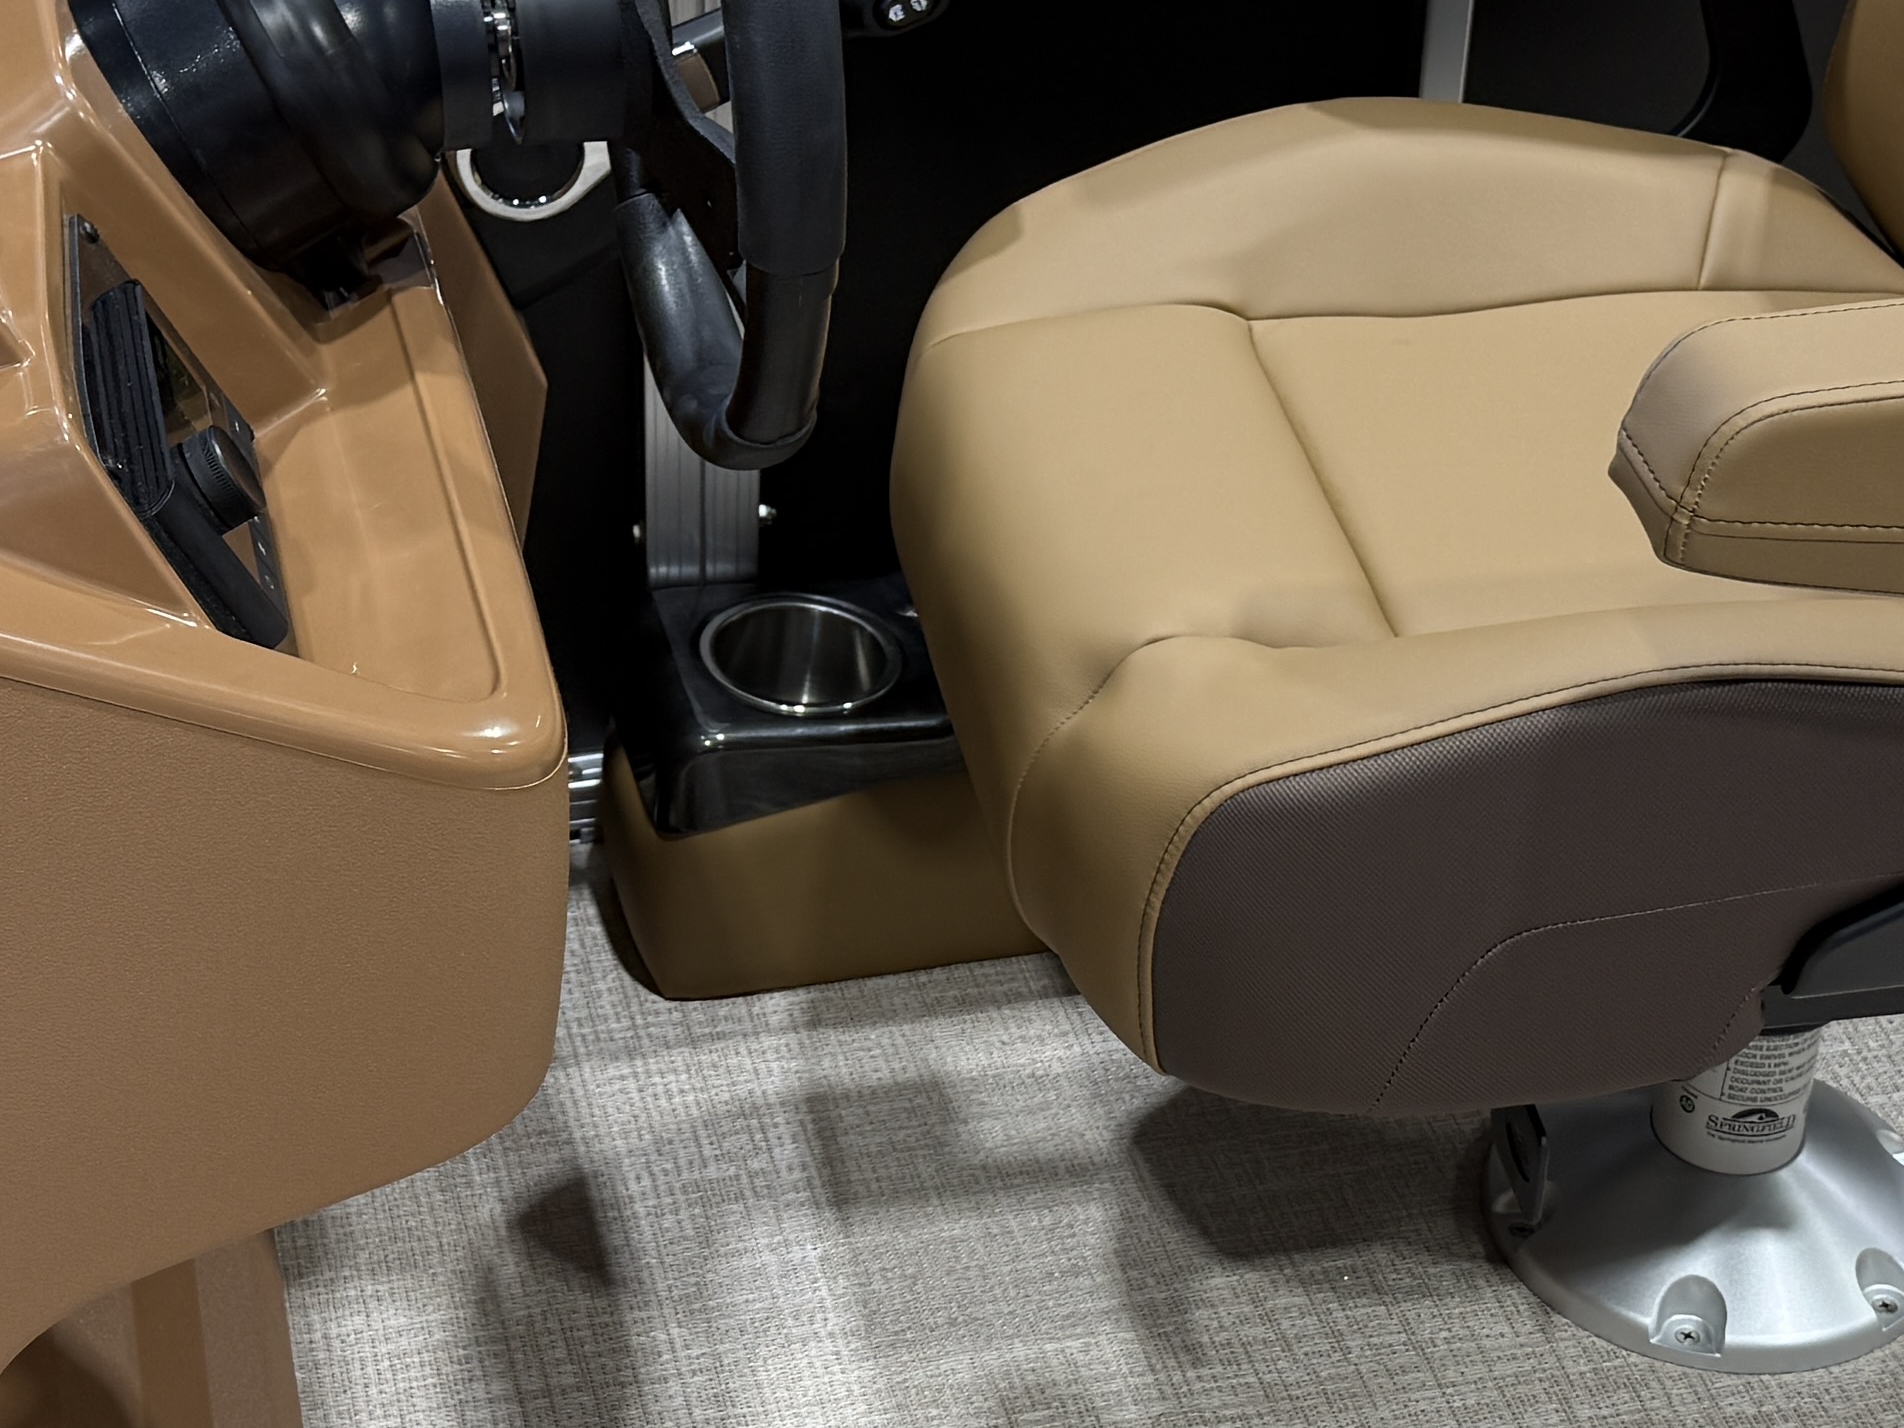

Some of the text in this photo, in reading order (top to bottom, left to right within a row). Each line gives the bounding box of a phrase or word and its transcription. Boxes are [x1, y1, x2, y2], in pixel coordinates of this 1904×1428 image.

[1730, 1076, 1771, 1085] OCCUPANT
[1728, 1084, 1784, 1094] BOAT CONTROL
